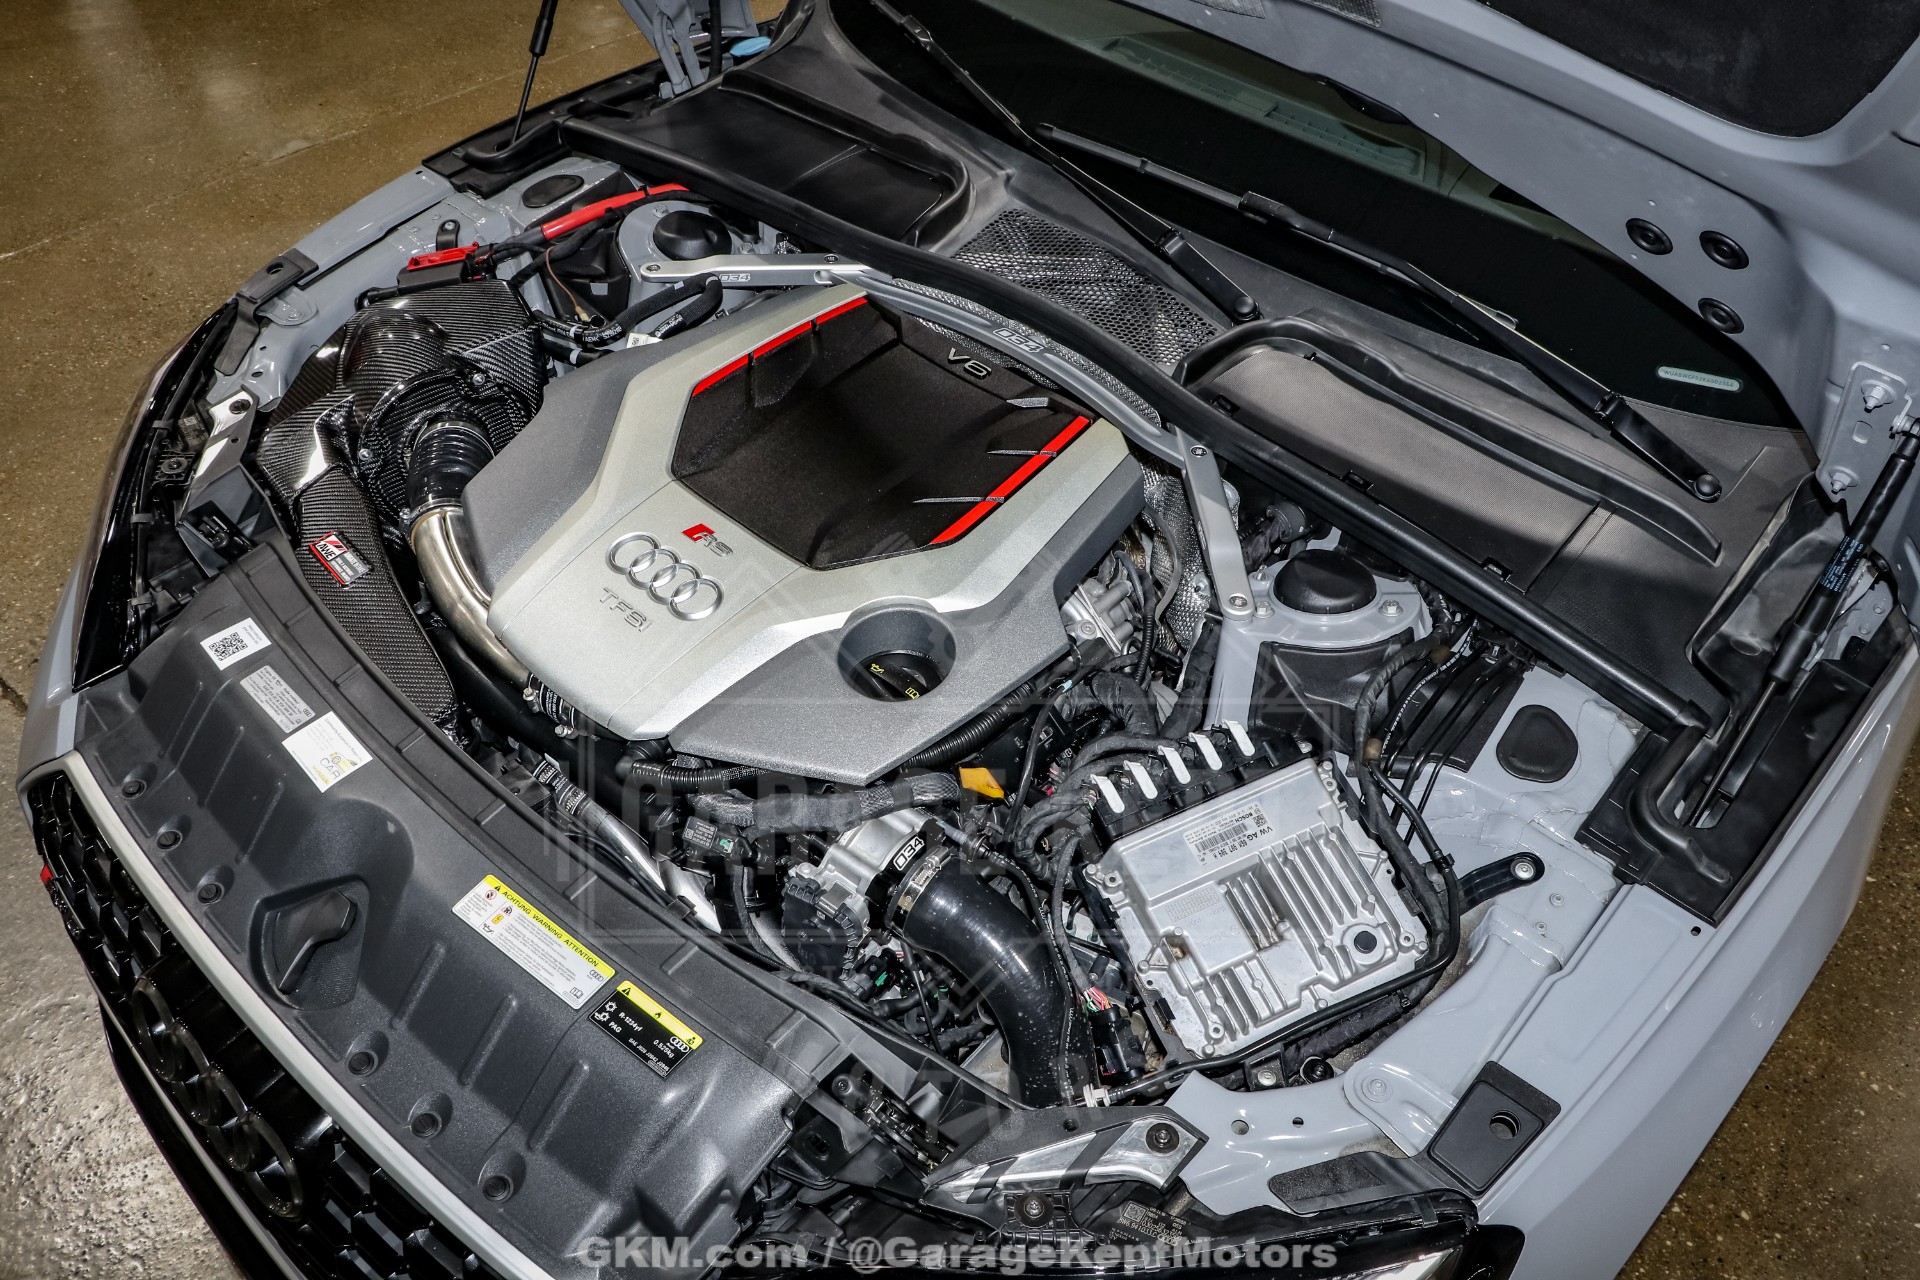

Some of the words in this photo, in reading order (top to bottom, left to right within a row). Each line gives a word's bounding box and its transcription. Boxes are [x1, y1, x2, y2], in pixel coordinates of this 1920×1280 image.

[720, 272, 749, 282] 034
[994, 327, 1043, 352] 034
[946, 347, 993, 382] V6
[316, 541, 336, 559] AWE
[598, 588, 653, 632] TFSI
[318, 756, 341, 779] CAR
[1234, 811, 1253, 823] BOSCH
[1246, 831, 1258, 841] AG
[1259, 825, 1272, 835] VW
[894, 837, 923, 869] 034
[501, 890, 532, 914] ACHTUNG
[532, 913, 563, 938] WARNING
[563, 938, 599, 967] ATTENTION
[608, 1020, 622, 1033] PAG
[618, 1011, 642, 1033] R-1234yf
